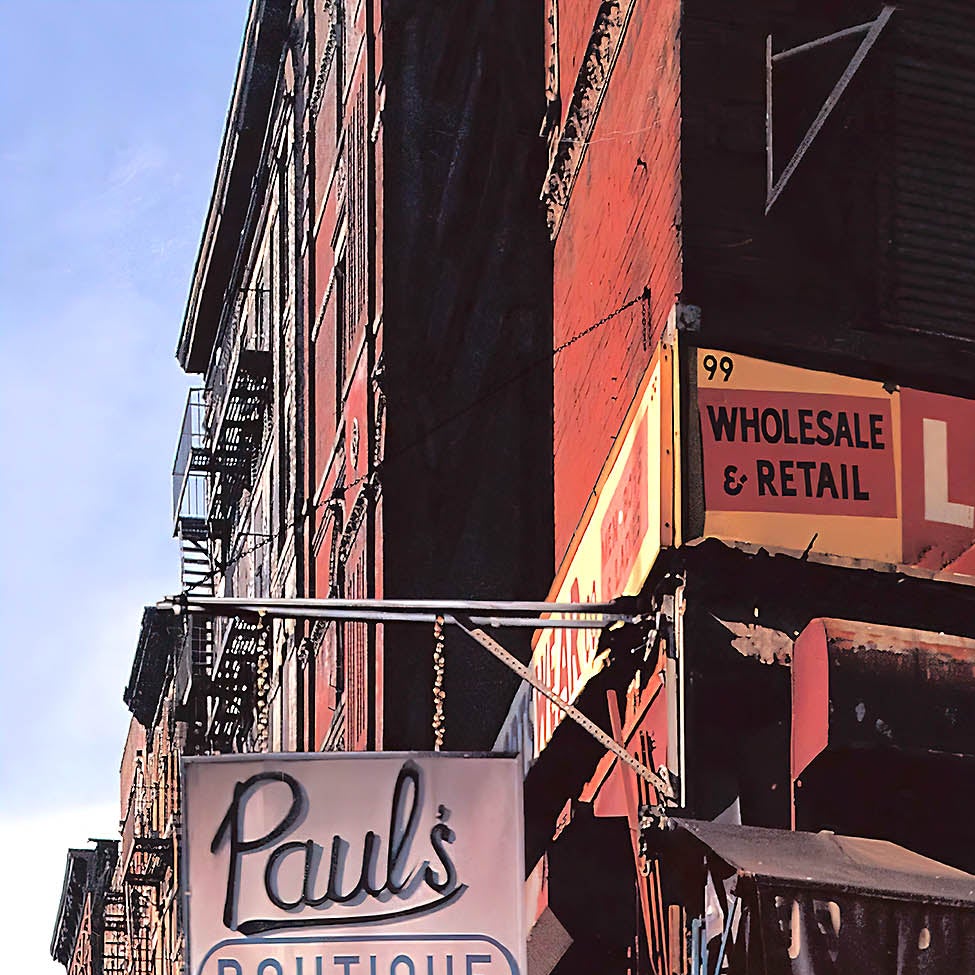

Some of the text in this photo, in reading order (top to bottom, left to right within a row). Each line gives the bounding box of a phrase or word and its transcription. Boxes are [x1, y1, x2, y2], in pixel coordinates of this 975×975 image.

[703, 354, 734, 382] 99
[706, 404, 886, 450] WHOLESALE
[723, 459, 870, 501] & RETAIL
[210, 759, 470, 937] Paul's
